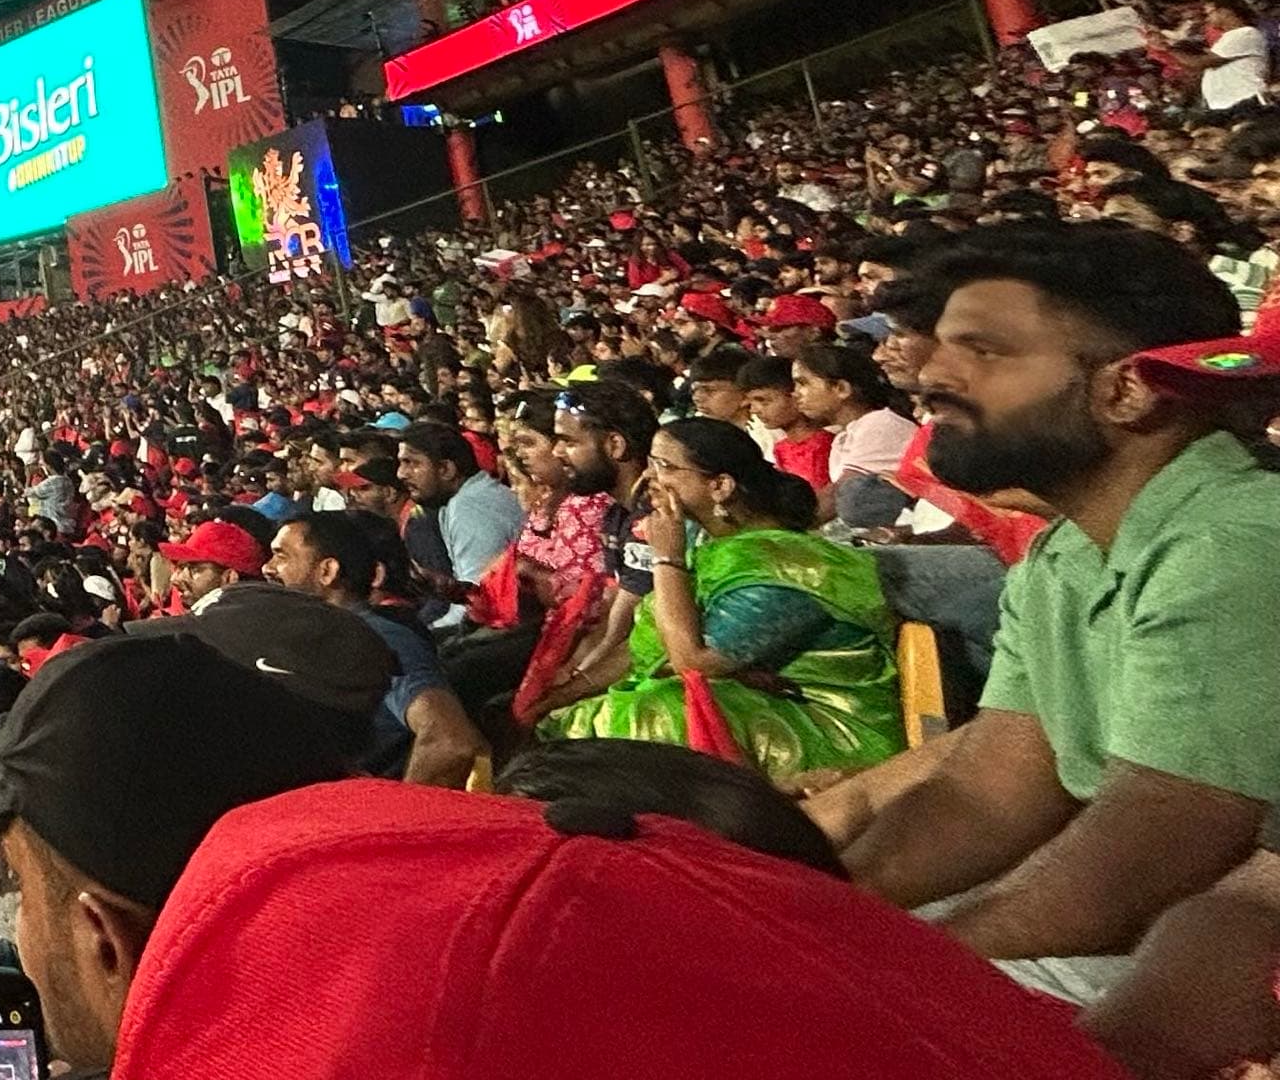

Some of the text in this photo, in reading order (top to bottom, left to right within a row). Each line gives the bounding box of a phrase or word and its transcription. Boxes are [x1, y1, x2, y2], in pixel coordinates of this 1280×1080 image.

[209, 65, 239, 82] TATA
[210, 74, 252, 110] IPL
[132, 248, 159, 275] IPL
